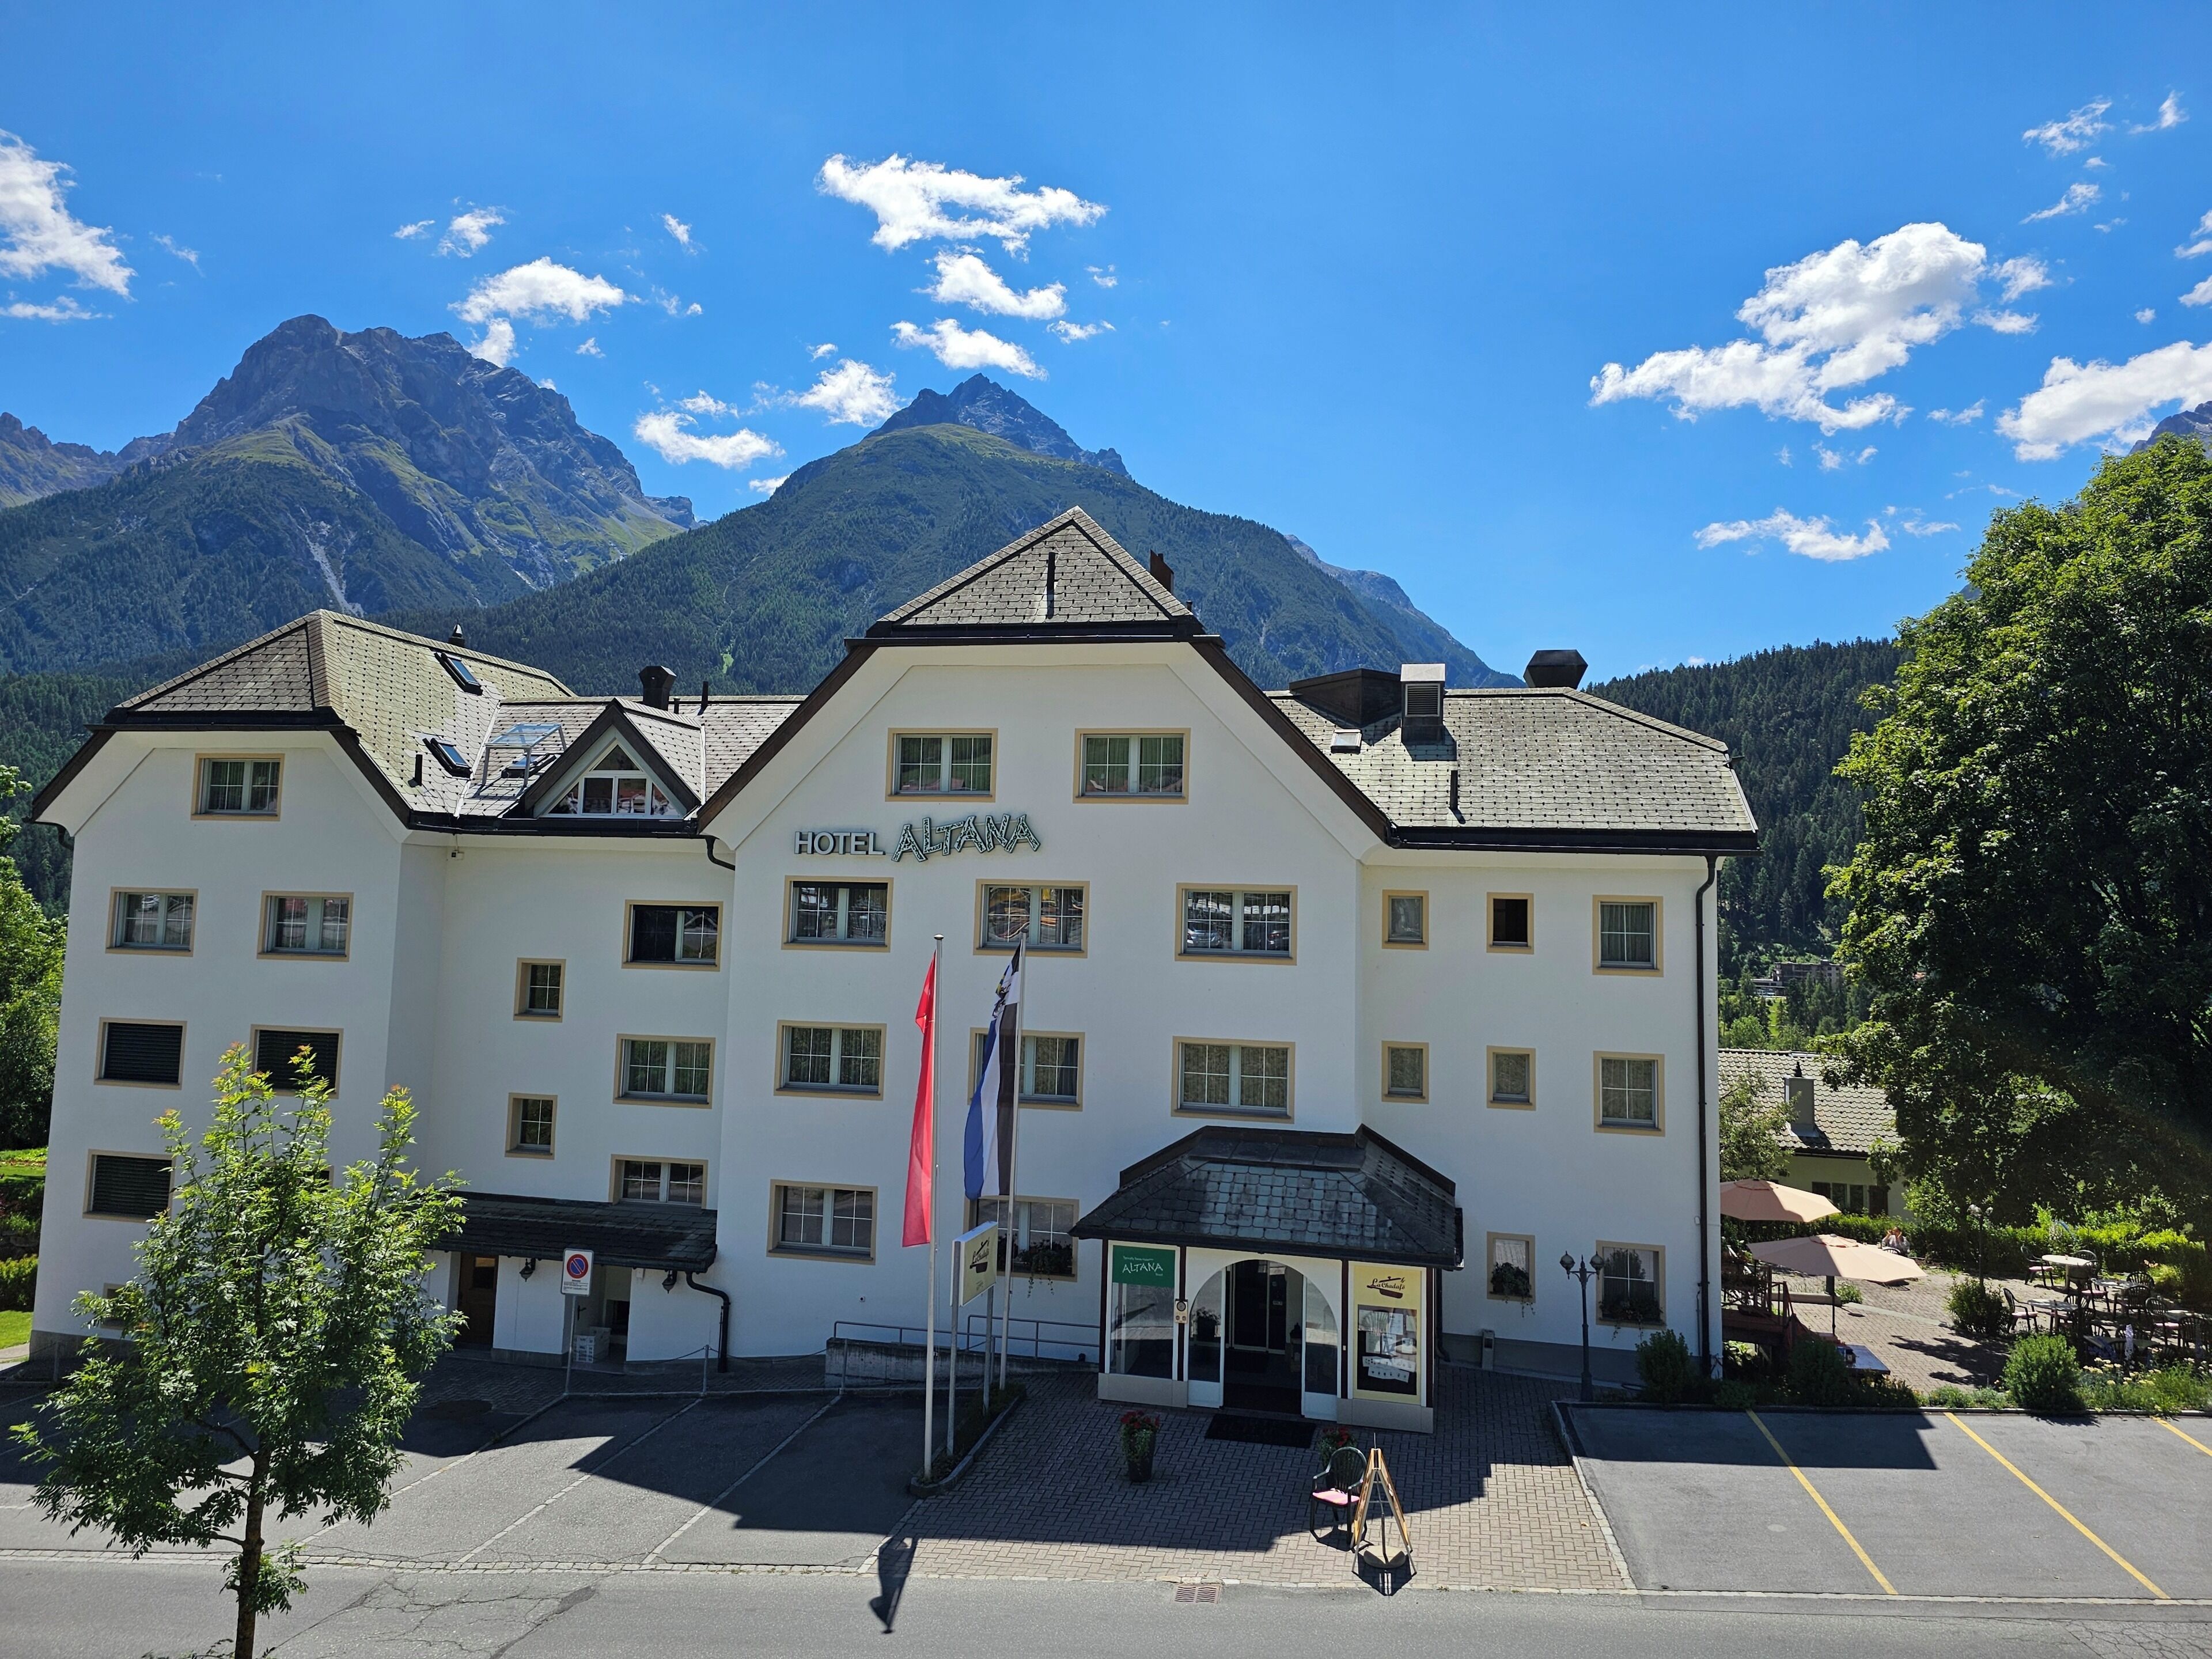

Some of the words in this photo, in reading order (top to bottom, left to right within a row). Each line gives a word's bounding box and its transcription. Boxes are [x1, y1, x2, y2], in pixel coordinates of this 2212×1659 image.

[794, 831, 885, 855] HOTEL
[891, 813, 1041, 862] ALTANA
[1122, 1262, 1164, 1274] ALTANA
[1370, 1278, 1381, 1287] La
